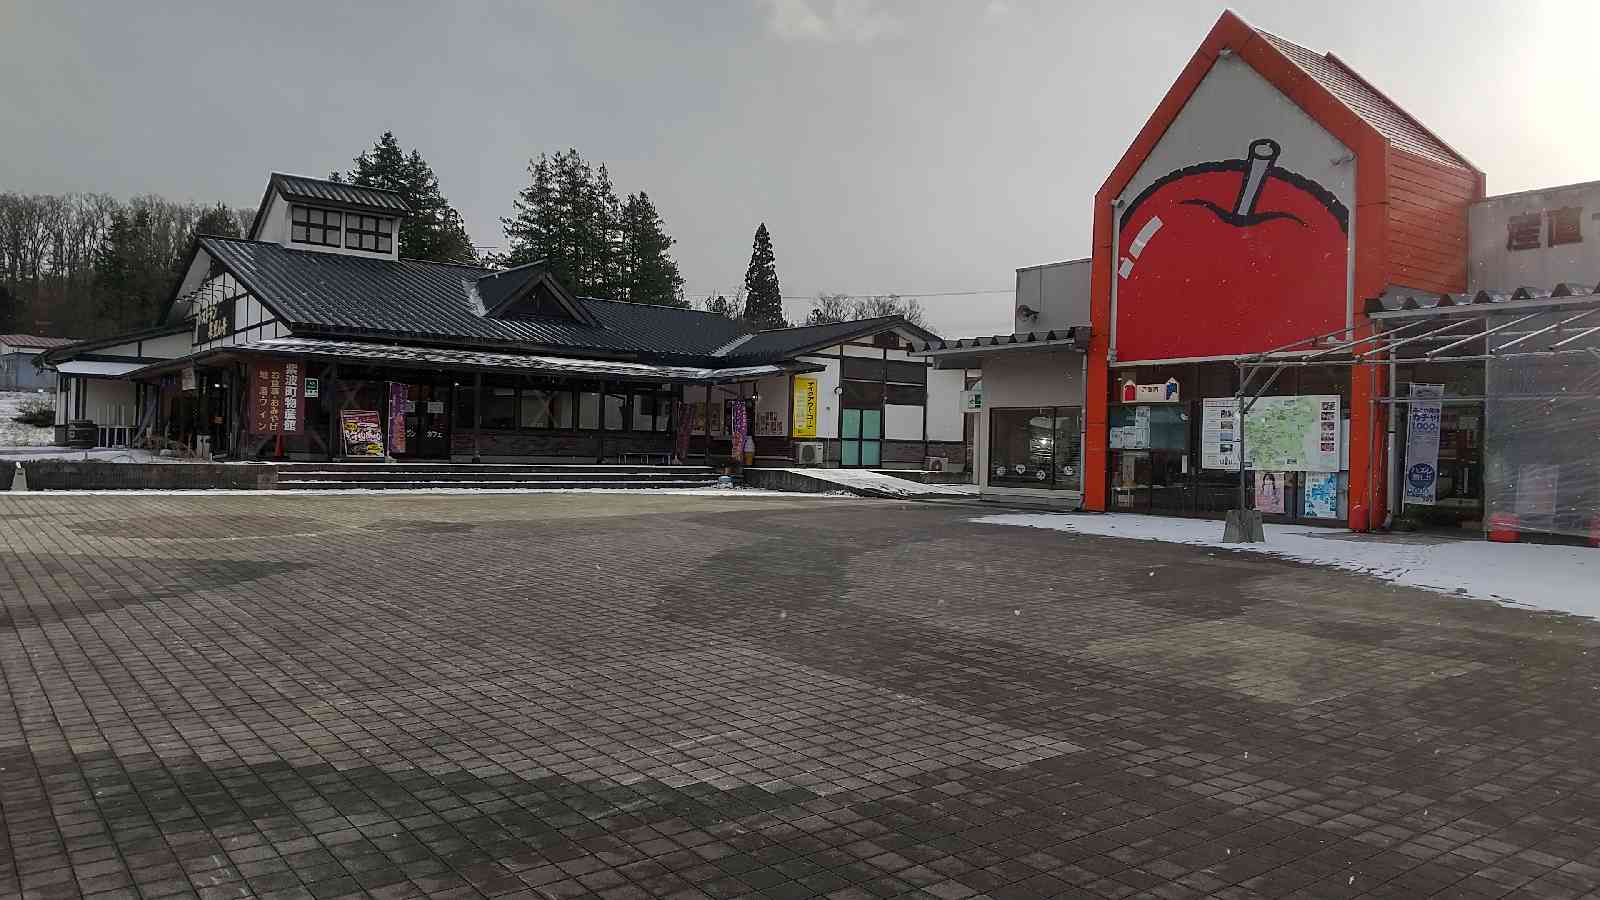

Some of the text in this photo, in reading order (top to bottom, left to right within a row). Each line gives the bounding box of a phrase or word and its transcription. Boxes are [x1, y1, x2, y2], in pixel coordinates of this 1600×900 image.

[284, 362, 298, 432] 紫波町物産館
